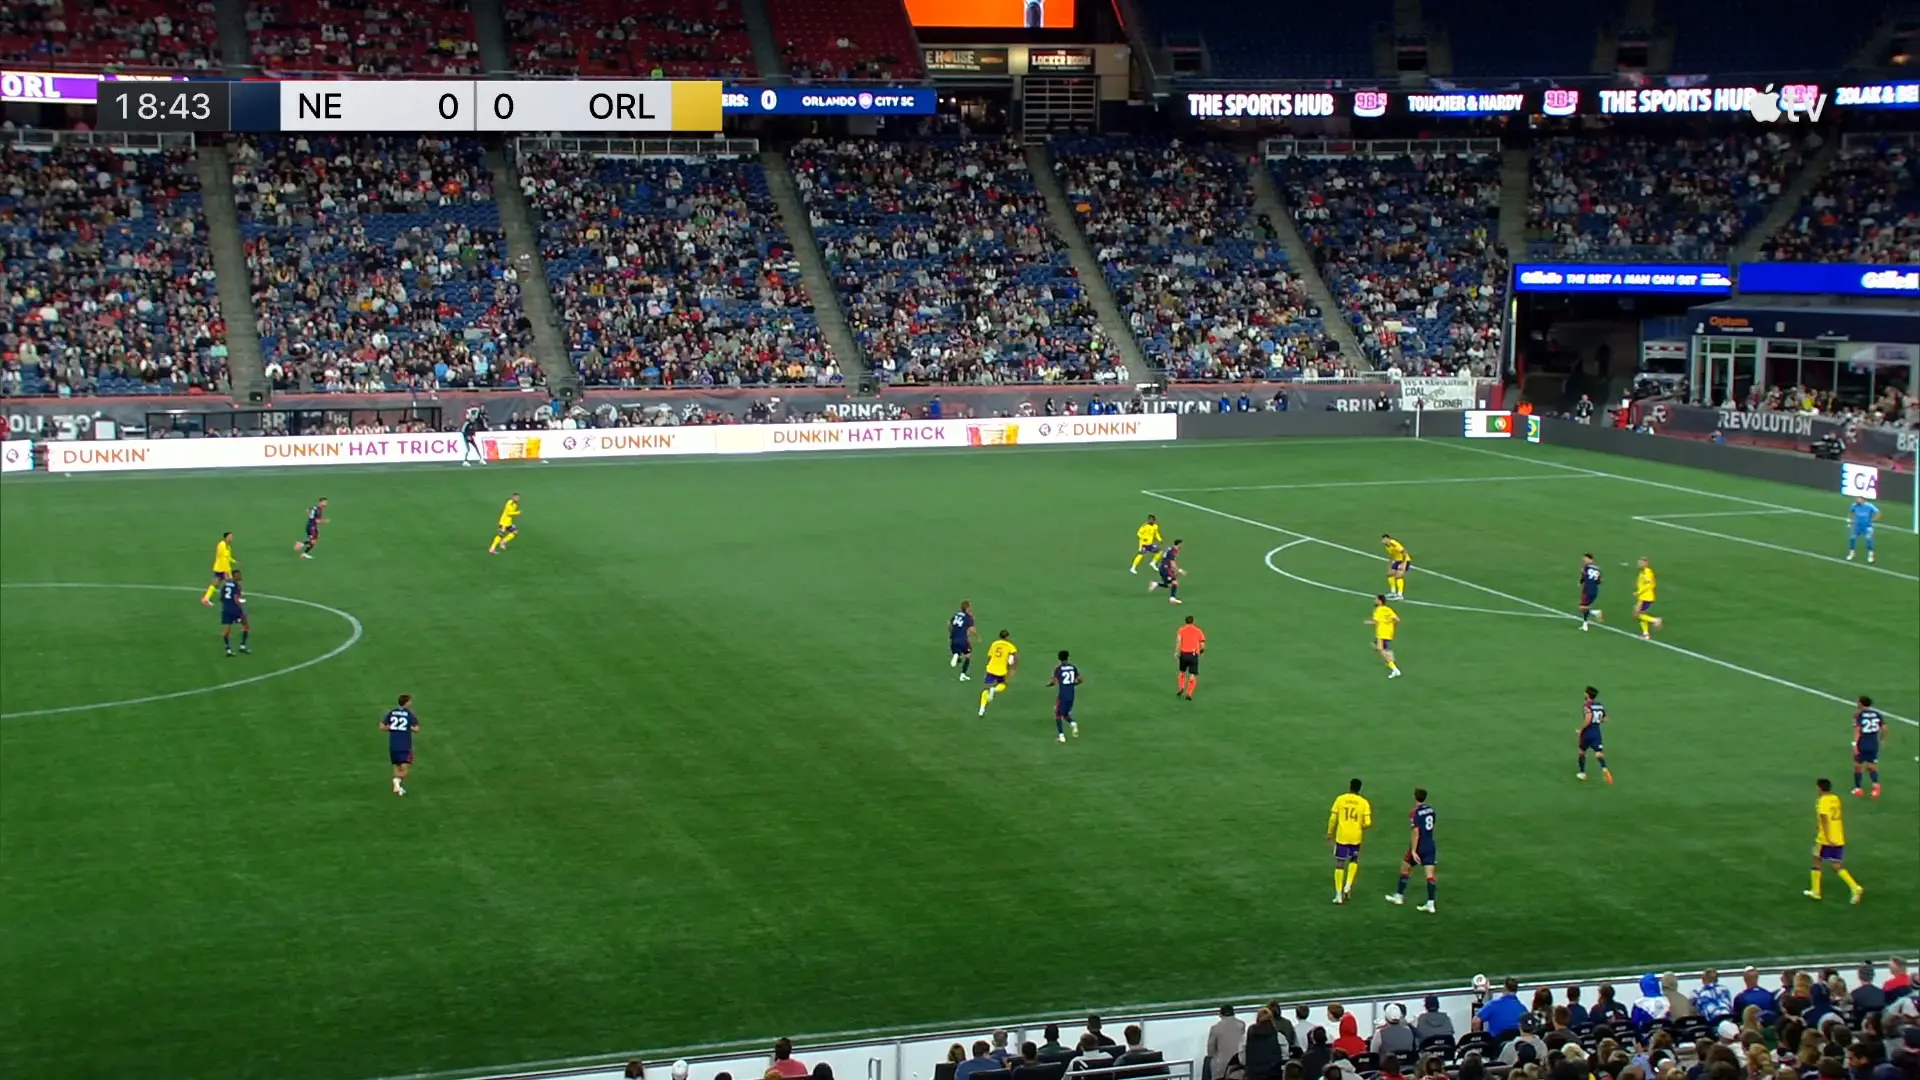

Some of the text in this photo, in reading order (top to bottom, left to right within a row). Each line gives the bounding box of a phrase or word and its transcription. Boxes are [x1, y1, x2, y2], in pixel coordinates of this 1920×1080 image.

[1, 74, 61, 98] ORL
[761, 90, 777, 110] 0
[802, 96, 915, 107] ORLANDO CITY SC
[1188, 94, 1334, 116] THE SPORTS HUB
[1408, 94, 1524, 111] TOUCHER & HARDY
[1600, 90, 1637, 113] THE
[1639, 89, 1712, 113] SPORTS
[1073, 422, 1141, 436] DUNKIN'
[1718, 411, 1812, 436] REVOLUTION
[601, 434, 675, 450] DUNKIN'
[774, 427, 945, 444] DUNKIN' HAT TRICK
[63, 448, 150, 464] DUNKIN'
[264, 439, 458, 458] DUNKIN' HAT TRICK
[225, 587, 232, 599] 2
[1062, 671, 1075, 684] 21
[390, 716, 408, 731] 22
[1861, 719, 1880, 733] 25
[1344, 807, 1358, 822] 14
[1425, 815, 1434, 831] 8
